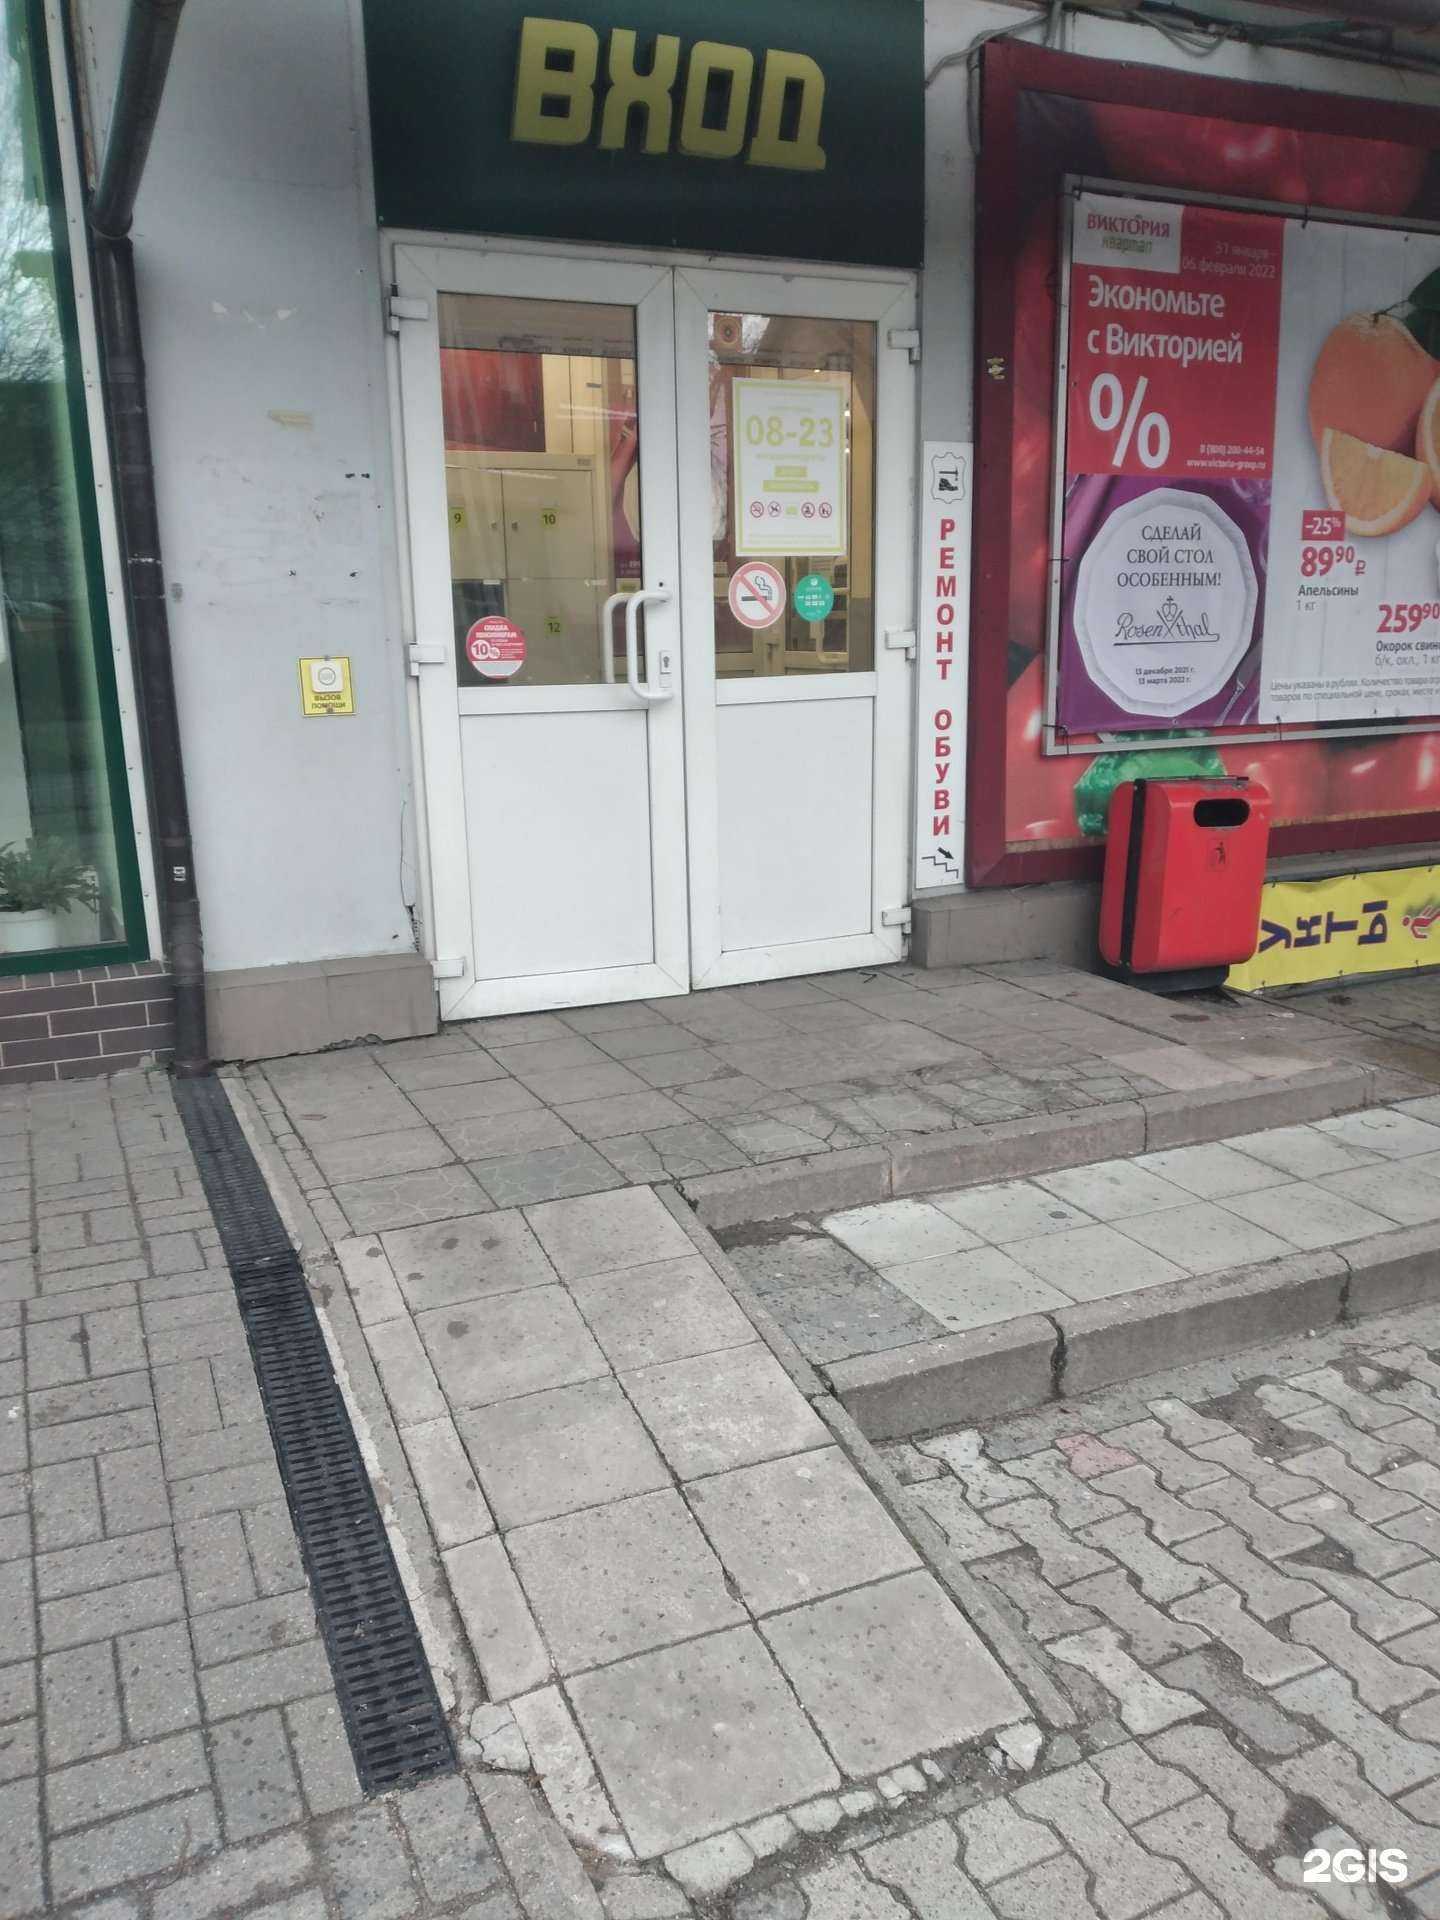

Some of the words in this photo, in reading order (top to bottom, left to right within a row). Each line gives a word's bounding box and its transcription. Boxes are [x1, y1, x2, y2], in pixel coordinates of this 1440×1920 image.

[510, 17, 827, 171] ВХОД
[1087, 214, 1171, 238] ВИКТОРИЯ
[1215, 241, 1229, 255] 31
[1250, 262, 1276, 278] 2022
[1087, 275, 1226, 318] Экономьте
[1087, 328, 1100, 354] с
[1105, 323, 1243, 368] Викторией
[1088, 372, 1171, 470] %
[746, 414, 834, 448] 08-23
[454, 512, 462, 525] 9
[543, 514, 556, 525] 10
[1141, 523, 1202, 542] СДЕЛАЙ
[1126, 546, 1170, 564] СВОЙ
[1174, 549, 1214, 564] СТОЛ
[1116, 572, 1222, 588] ОСОБЕННЫМ!
[935, 518, 957, 681] РЕМОНТ
[1298, 584, 1359, 597] Апельсины
[547, 622, 560, 633] 12
[1114, 611, 1220, 645] Rosenthal
[473, 643, 488, 656] 10
[1376, 640, 1413, 654] Окорок
[1415, 641, 1440, 651] свин
[932, 708, 953, 836] ОБУВИ
[1258, 900, 1388, 953] УКТЫ
